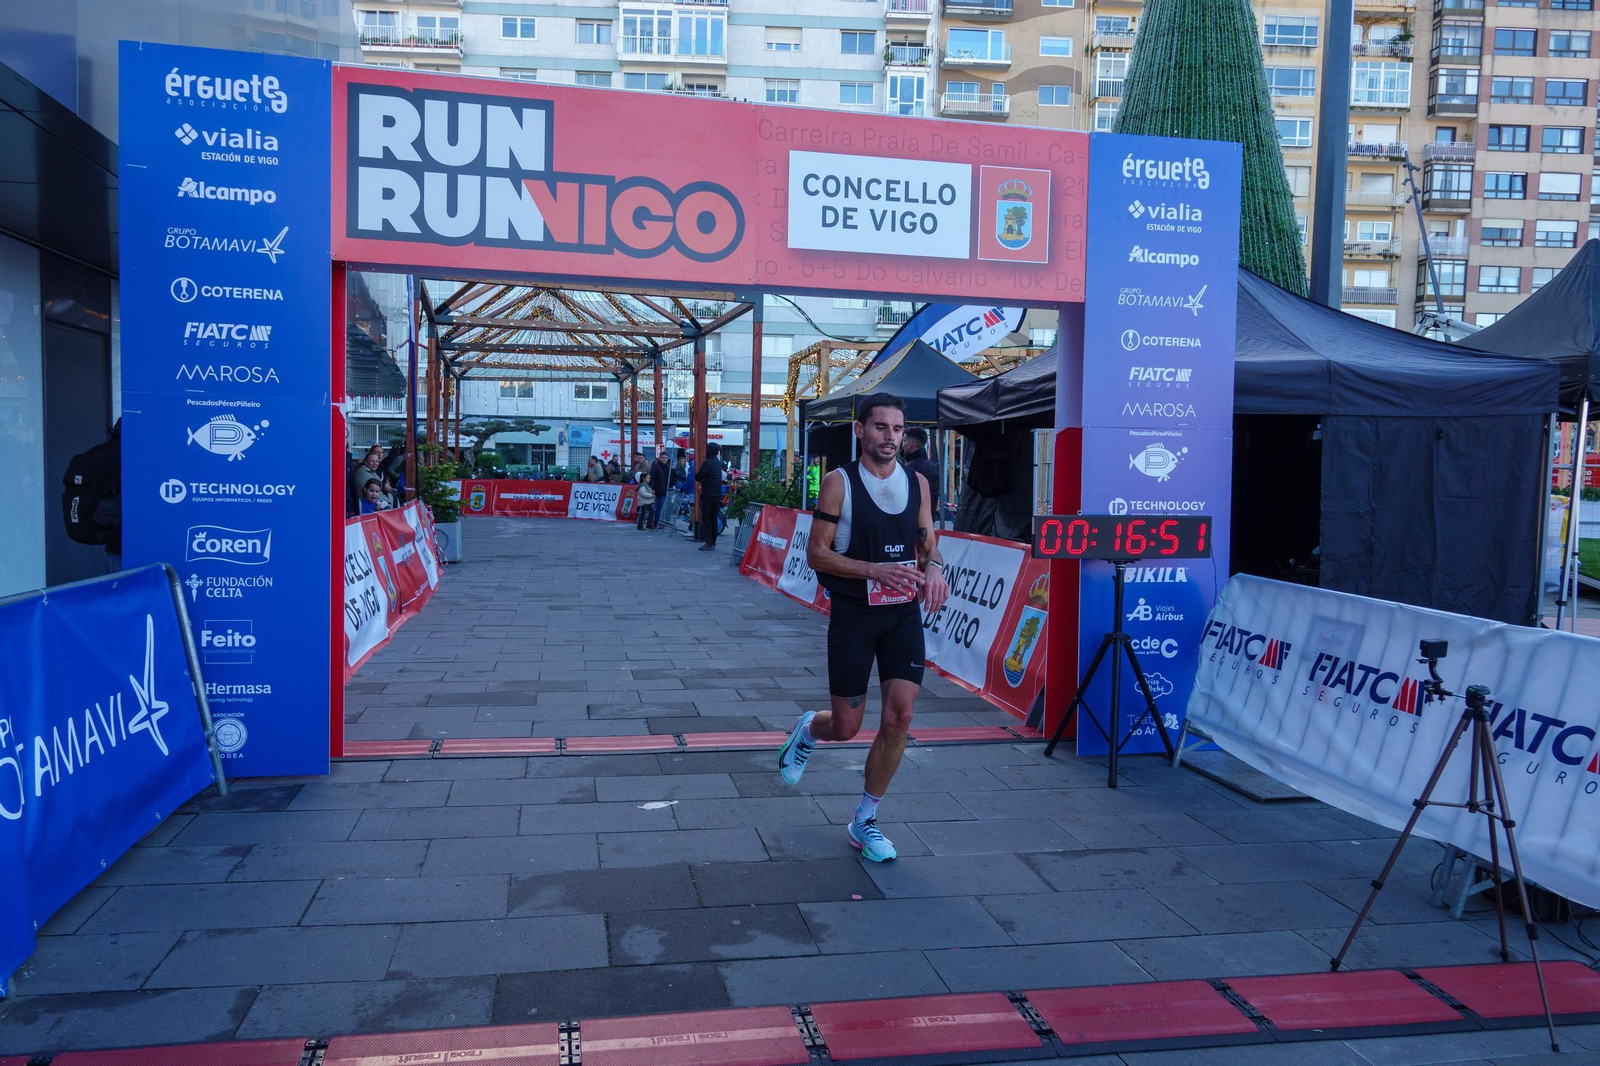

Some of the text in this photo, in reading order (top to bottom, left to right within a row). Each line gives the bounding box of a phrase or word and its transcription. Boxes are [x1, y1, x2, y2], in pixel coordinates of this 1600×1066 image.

[202, 128, 279, 151] vialia
[358, 93, 546, 171] RUN
[758, 119, 853, 148] Carreira
[863, 127, 920, 153] Praia
[930, 133, 959, 156] De
[967, 136, 1028, 161] Samil
[201, 152, 279, 165] ESTACIÓN DE VIGO
[177, 177, 277, 205] Alcampo
[802, 173, 957, 206] CONCELLO
[821, 205, 938, 235] DE VIGO
[1148, 203, 1202, 222] vialia
[167, 227, 197, 236] GRUPO
[1146, 223, 1175, 232] ESTACIÓN
[1187, 226, 1202, 234] VIGO
[164, 235, 257, 253] BOTAMAVI
[1128, 245, 1200, 268] Alcampo
[801, 258, 847, 280] 5+5
[856, 260, 886, 282] Do
[895, 263, 988, 288] Calvario
[1009, 270, 1045, 291] 10k
[1054, 271, 1083, 293] De
[201, 285, 284, 301] COTERENA
[1118, 294, 1184, 308] BOTAMAVI
[184, 322, 248, 340] FIATC
[951, 322, 1009, 356] GUROS
[183, 339, 269, 349] SEGUROS
[1142, 336, 1202, 348] COTERENA
[176, 364, 280, 383] MAROSA
[1129, 367, 1175, 381] FIATC
[1128, 381, 1189, 389] SEGUROS
[186, 399, 261, 408] PescadosPérezPiñeiro
[1122, 402, 1196, 417] MAROSA
[190, 482, 296, 496] TECHNOLOGY
[574, 490, 617, 502] CONCELLO
[576, 502, 610, 513] DE VGO
[1130, 500, 1206, 511] TECHNOLOGY
[206, 575, 273, 587] FUNDACIÓN
[1123, 567, 1187, 583] BIKILA
[206, 588, 243, 598] CELTA
[942, 564, 1004, 610] ONCELLO
[1155, 604, 1175, 613] Viajes
[1155, 613, 1184, 621] Airbus
[945, 608, 980, 649] VIGO
[201, 629, 256, 647] Feito
[1200, 619, 1267, 662] FIATC
[1209, 652, 1279, 686] EGUROS
[1308, 652, 1399, 705] FIATC
[205, 683, 271, 694] Hermasa
[1302, 685, 1419, 734] SEGUROS
[1145, 727, 1156, 735] Ar
[1464, 701, 1597, 766] IATC
